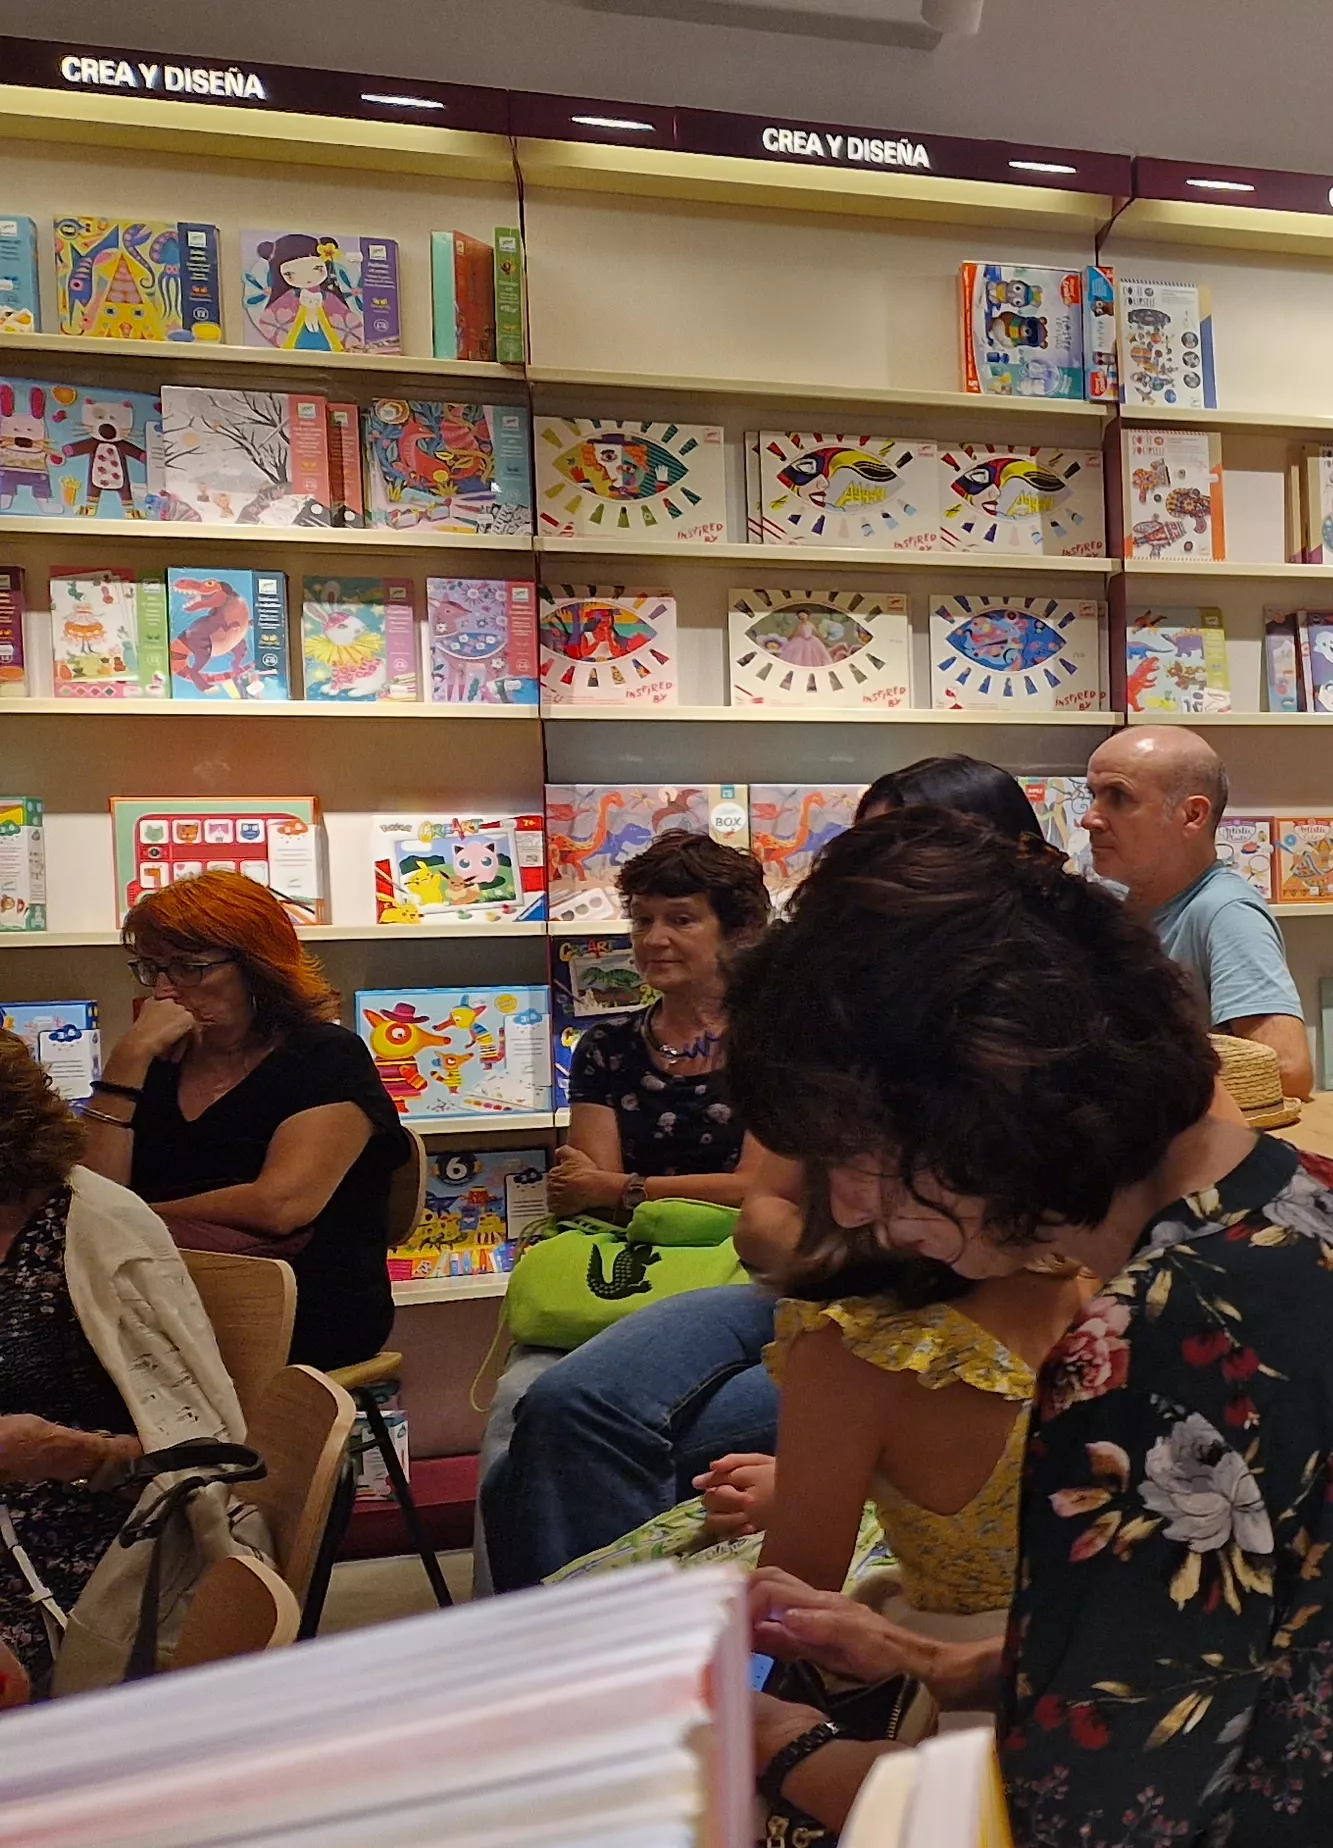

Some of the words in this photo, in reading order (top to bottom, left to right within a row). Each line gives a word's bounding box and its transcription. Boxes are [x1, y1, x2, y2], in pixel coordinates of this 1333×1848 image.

[60, 55, 137, 87] CREA
[138, 63, 159, 89] Y
[164, 65, 267, 100] DISEÑA
[762, 127, 826, 157] CREA
[826, 134, 843, 160] Y
[847, 137, 932, 170] DISEÑA
[677, 522, 723, 539] INSPIRED
[893, 533, 937, 549] INSPIRED
[1061, 541, 1103, 557] INSPIRED
[626, 681, 673, 699] INSPIRED
[653, 693, 667, 703] BY
[862, 686, 906, 703] INSPIRED
[1055, 690, 1096, 707] INSPIRED
[888, 698, 900, 708] BY
[1079, 701, 1091, 711] BY
[715, 816, 742, 828] BOX
[446, 1156, 469, 1177] 6
